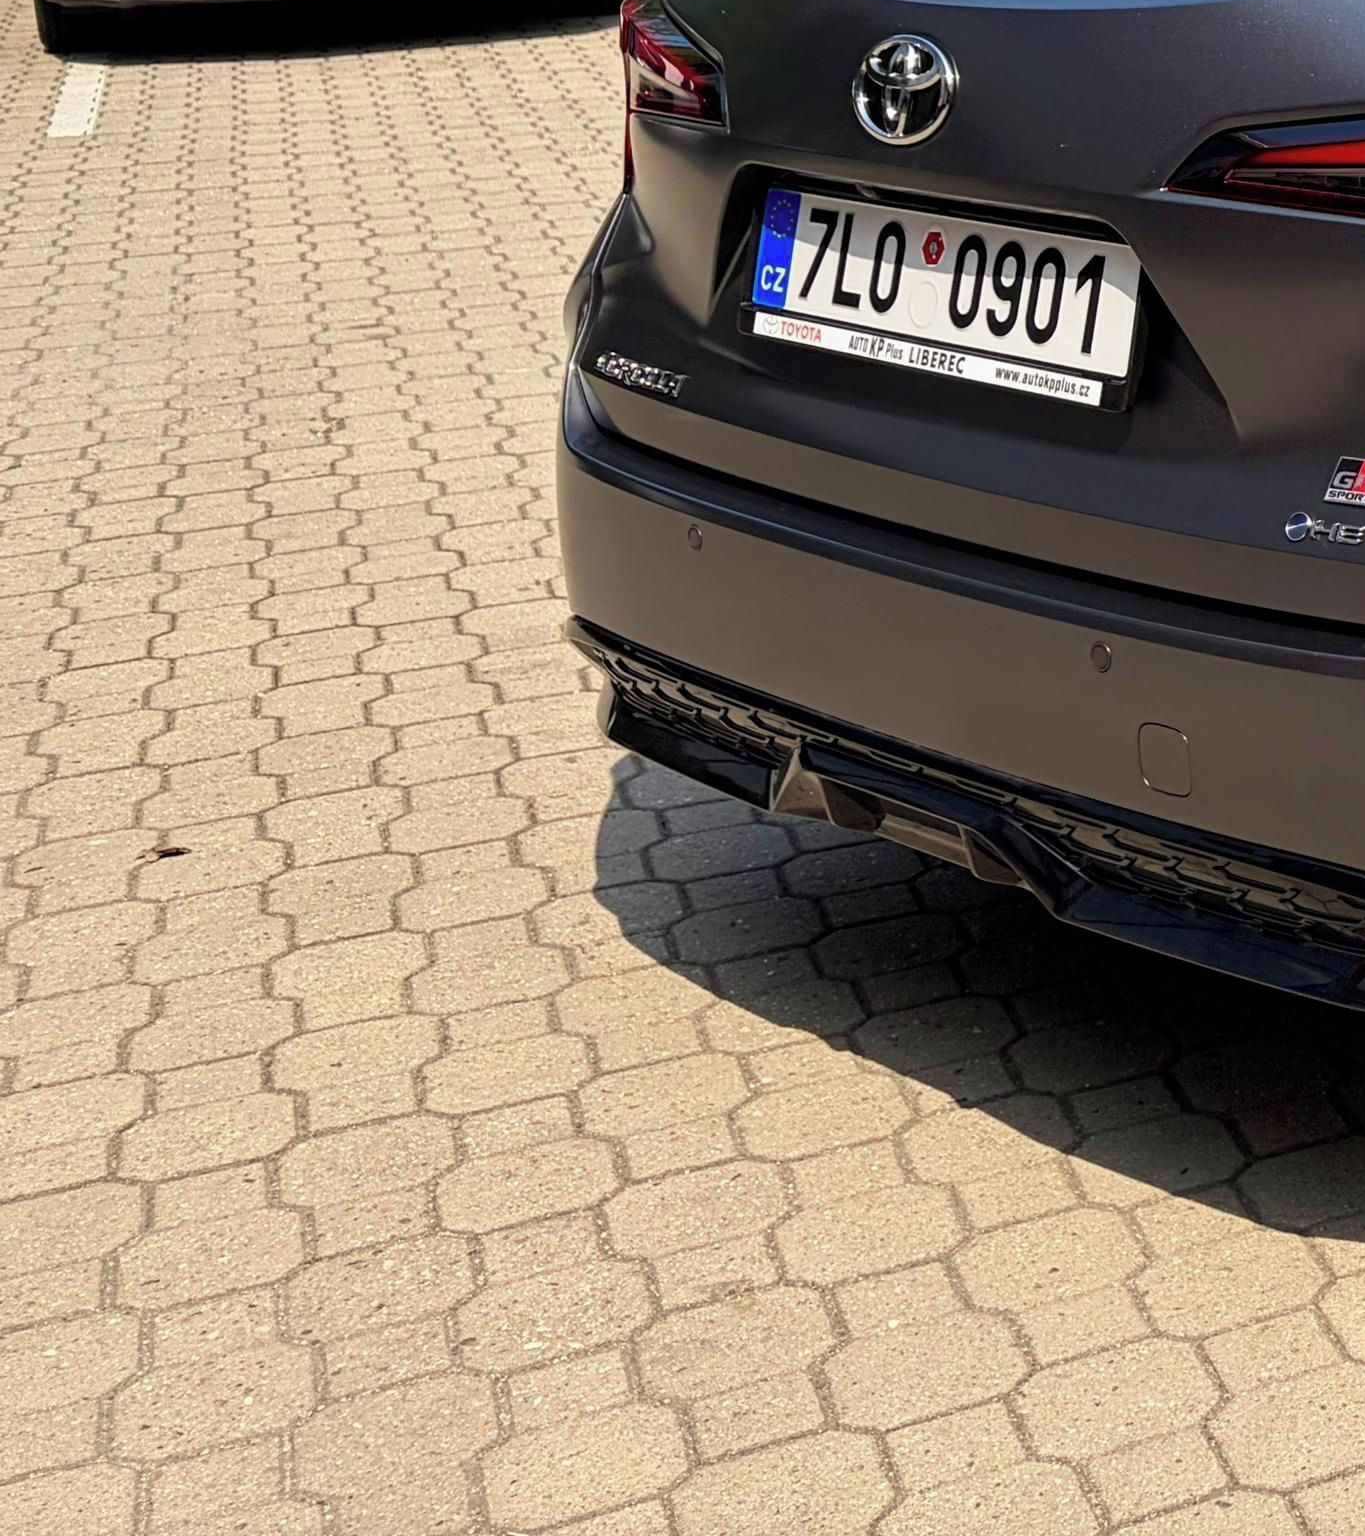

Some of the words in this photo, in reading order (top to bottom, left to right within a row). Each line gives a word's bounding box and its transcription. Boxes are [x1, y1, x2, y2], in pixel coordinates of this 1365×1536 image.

[760, 264, 786, 293] CZ
[799, 207, 906, 314] 7L0
[949, 234, 1106, 356] 0901
[781, 321, 822, 342] TOYOTA
[848, 335, 869, 353] AUTO
[869, 337, 885, 358] KP
[885, 344, 903, 360] Plus
[908, 346, 966, 374] LIBEREC
[995, 366, 1090, 398] www.autokpplus.cz
